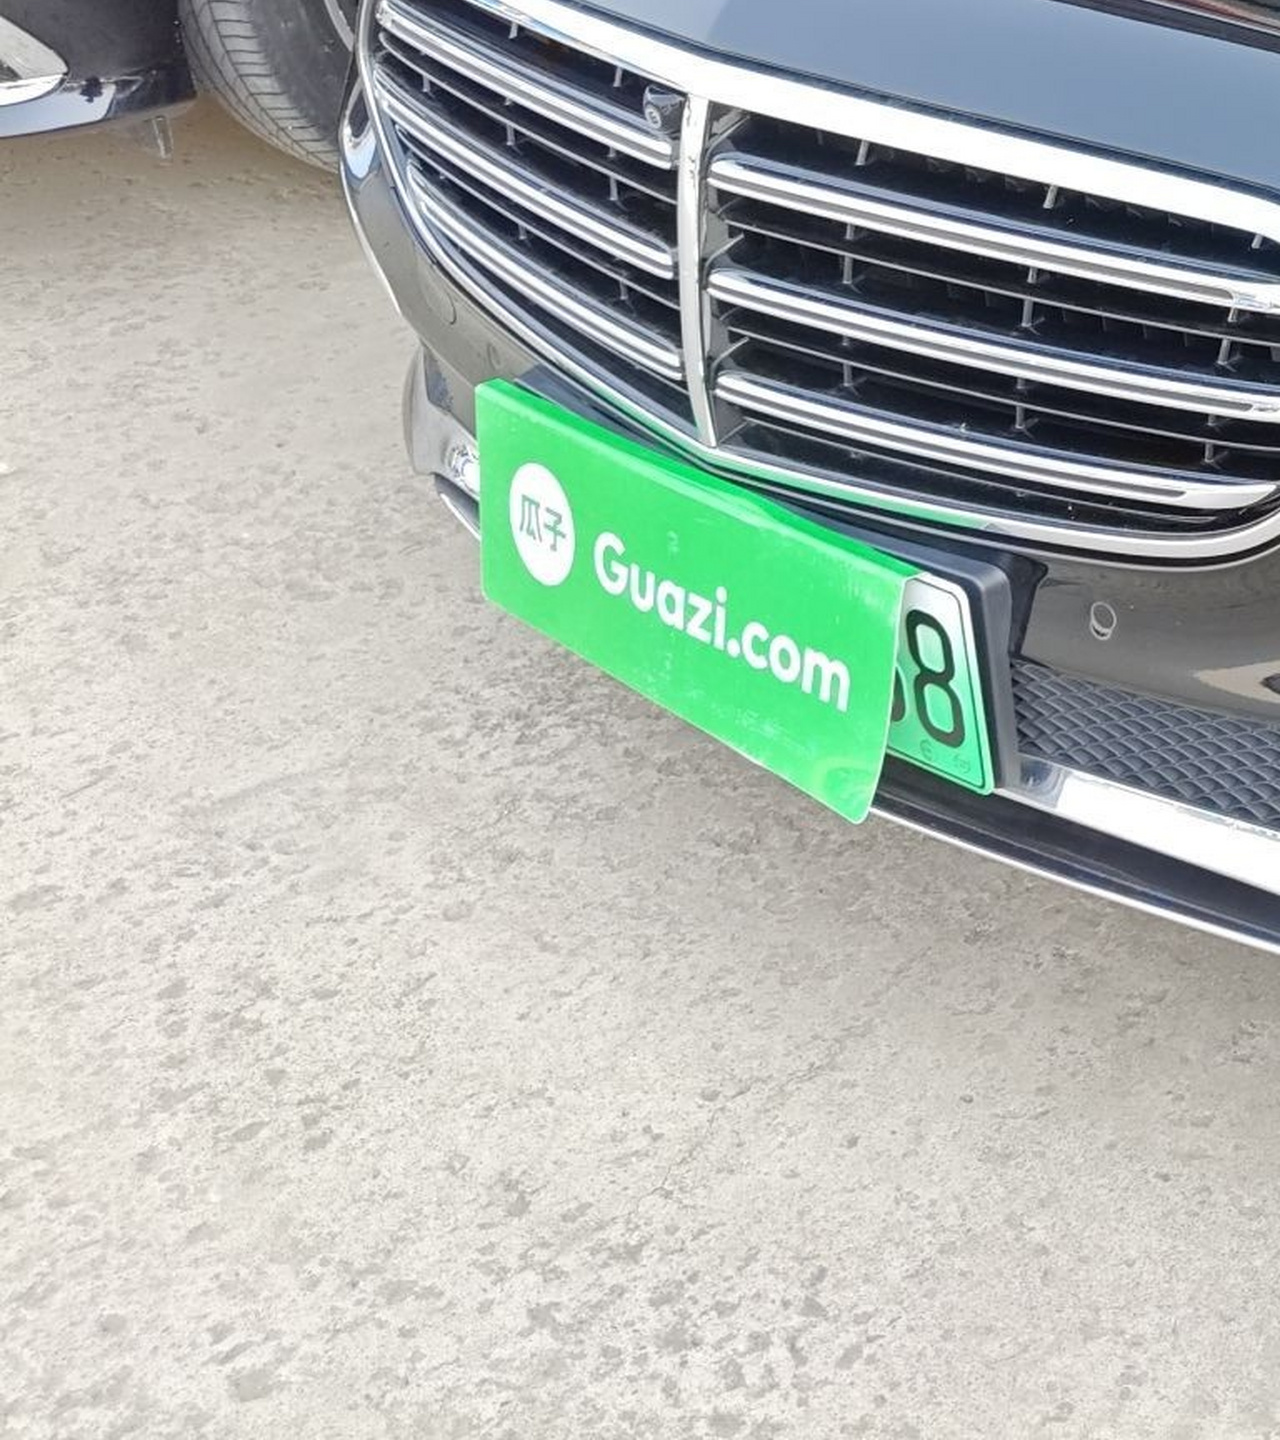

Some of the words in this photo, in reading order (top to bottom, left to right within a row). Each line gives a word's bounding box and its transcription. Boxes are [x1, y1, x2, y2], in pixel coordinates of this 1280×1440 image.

[520, 494, 566, 551] 瓜子
[593, 531, 851, 712] Guazi.com
[891, 609, 966, 748] 8
